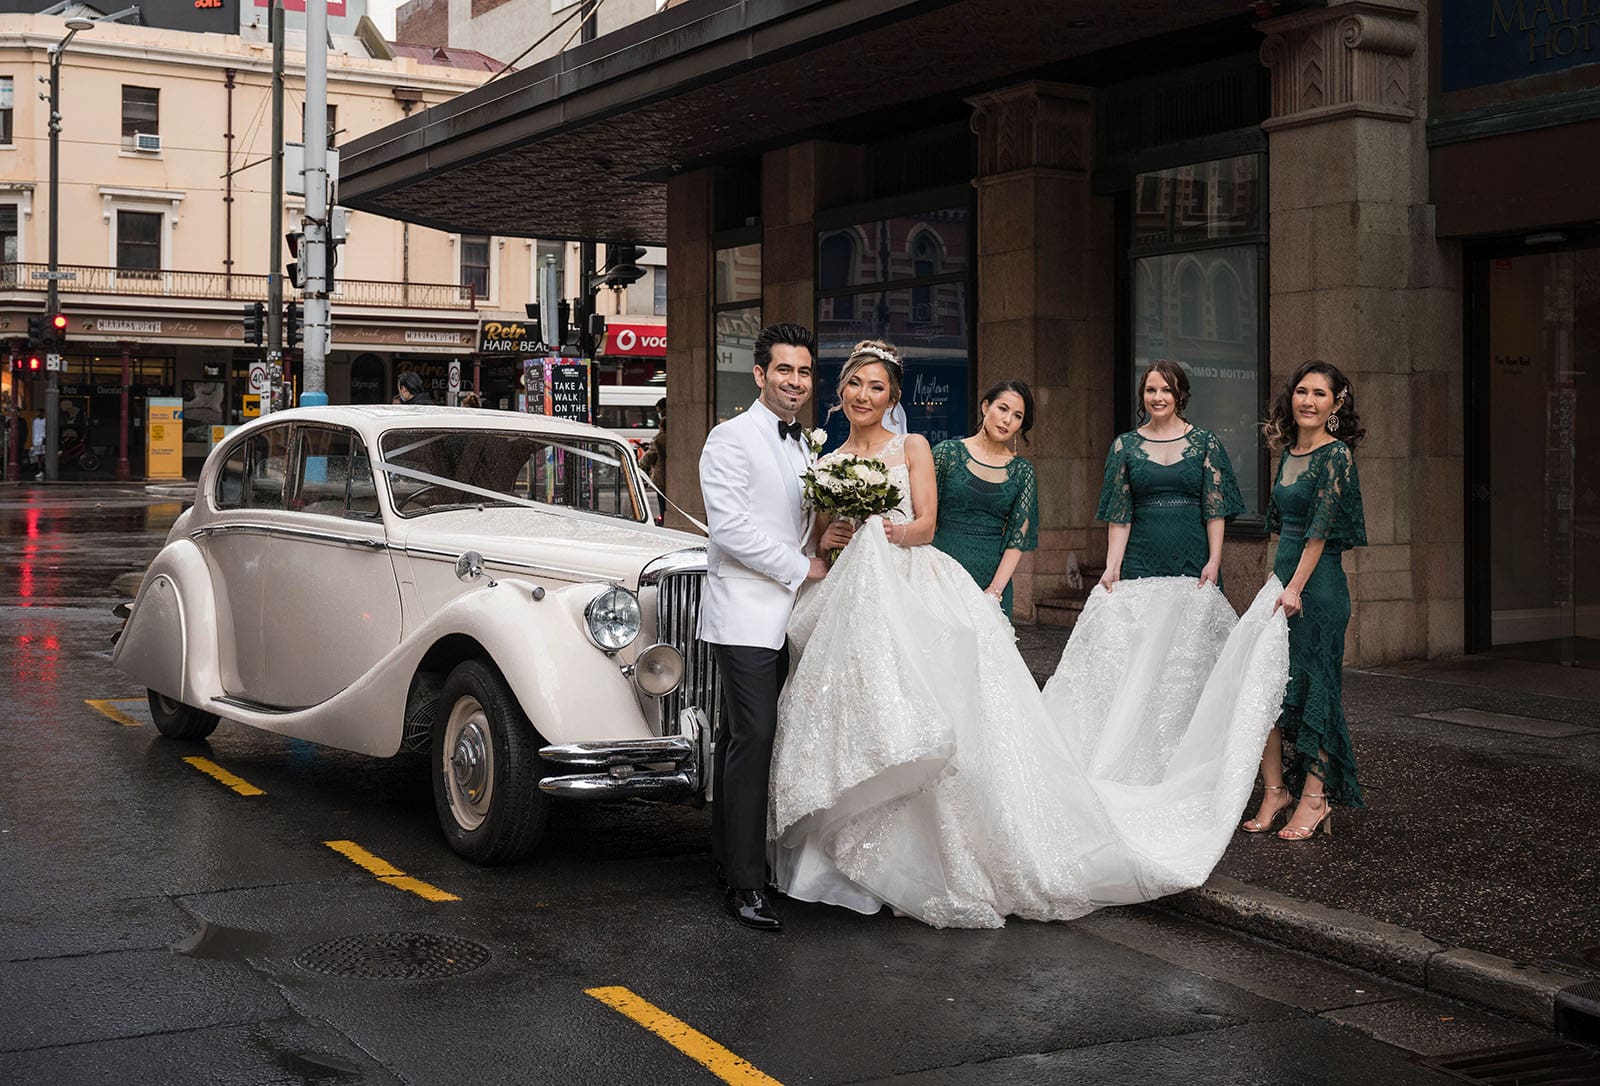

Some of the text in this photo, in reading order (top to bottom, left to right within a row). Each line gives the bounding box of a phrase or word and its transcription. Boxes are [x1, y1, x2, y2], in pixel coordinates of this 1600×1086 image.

[97, 319, 161, 333] CHARLESWORTH
[484, 322, 527, 340] Retr
[405, 330, 460, 344] CHARLESWORTH
[554, 382, 576, 391] TAKE
[578, 382, 584, 391] A
